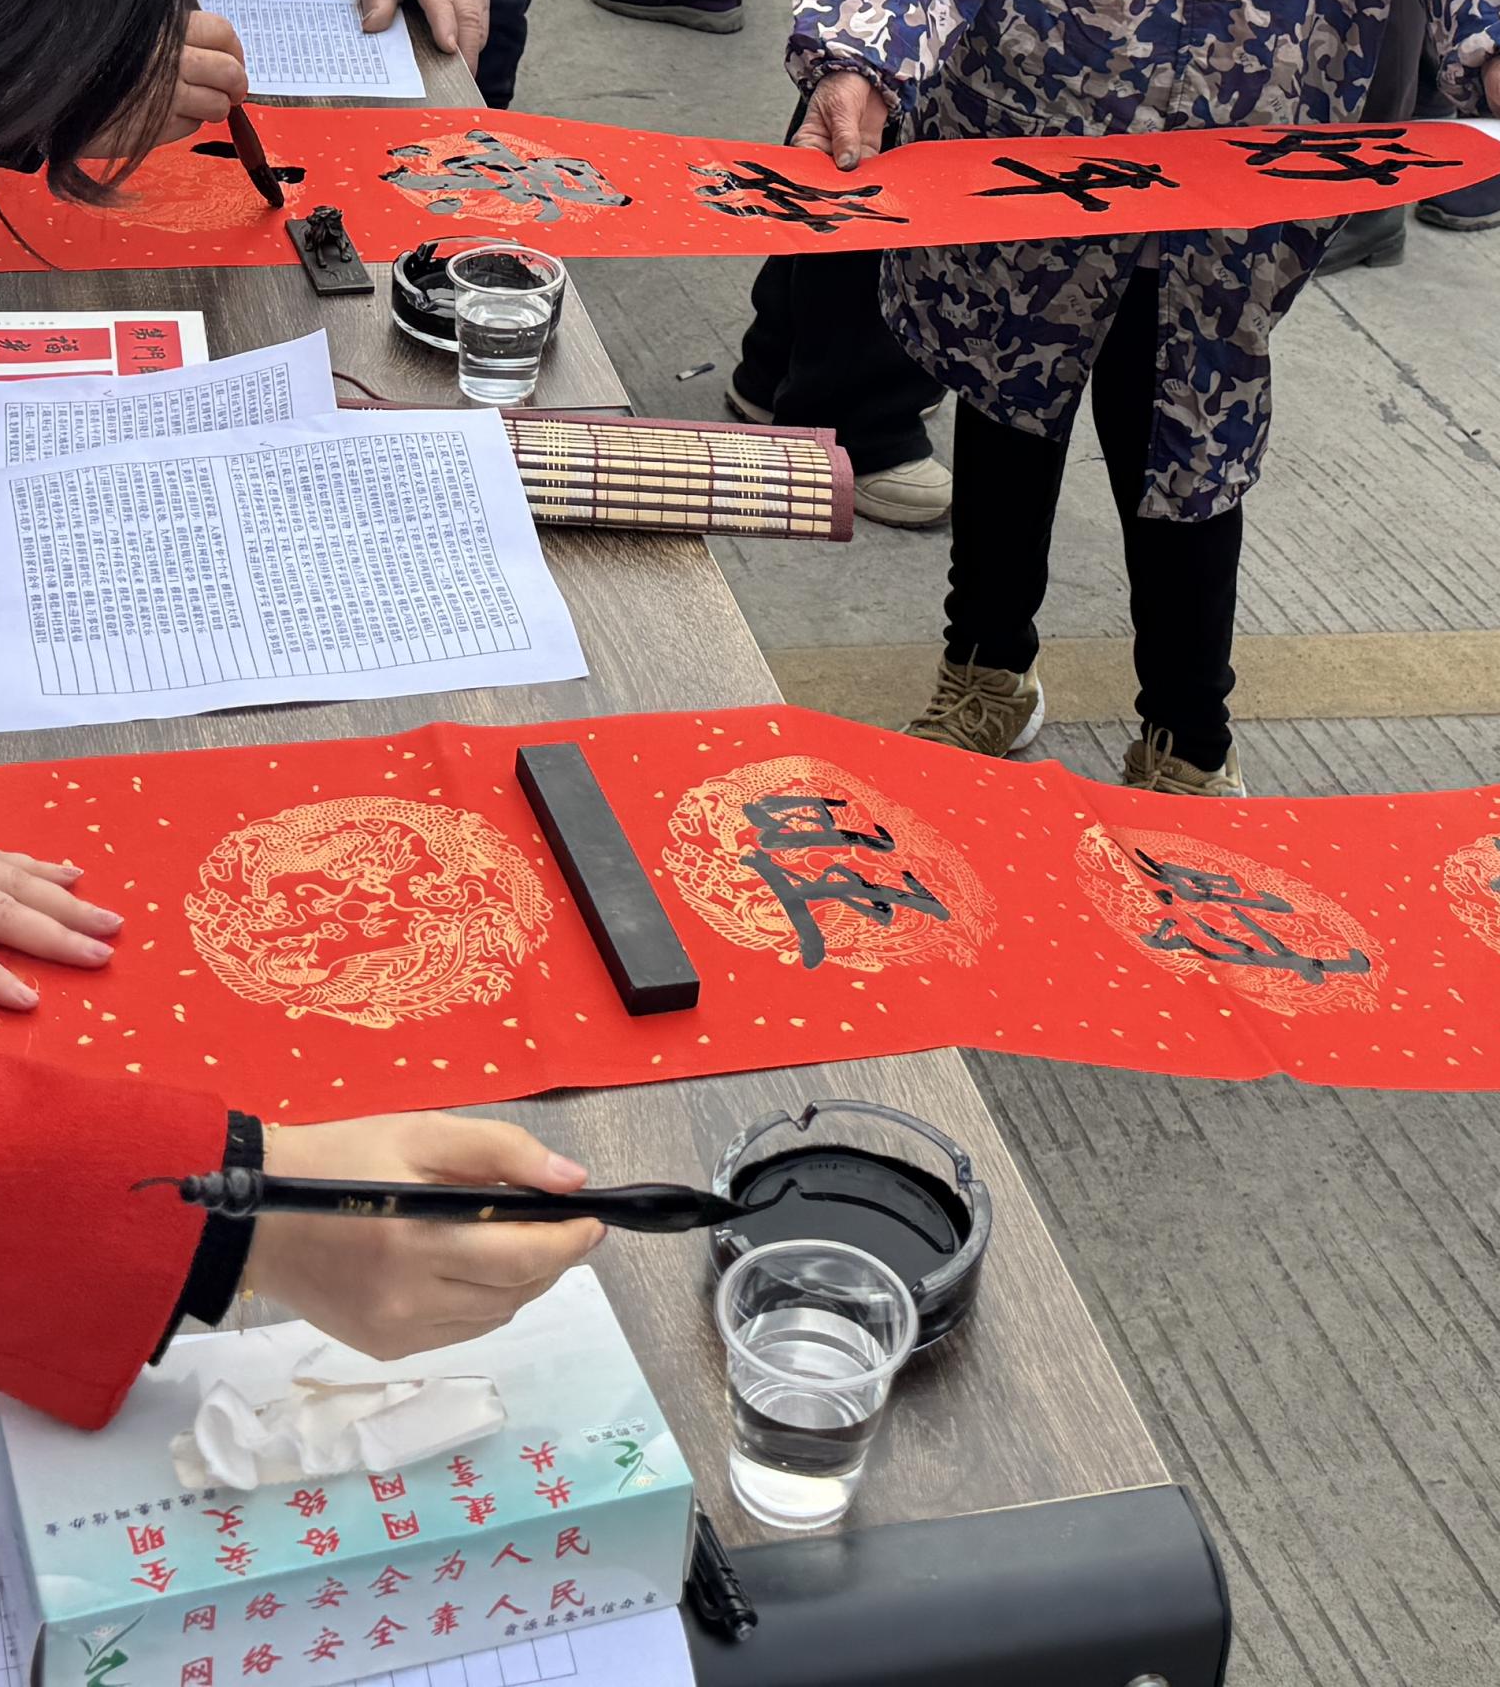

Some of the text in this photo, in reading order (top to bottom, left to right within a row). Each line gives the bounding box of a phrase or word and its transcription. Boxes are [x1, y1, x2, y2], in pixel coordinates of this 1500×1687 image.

[127, 1440, 559, 1556] 共享网络文明
[131, 1475, 575, 1595] 共建网络安全
[180, 1579, 587, 1687] 网络安全靠人民
[181, 1526, 591, 1633] 网络安全为人民
